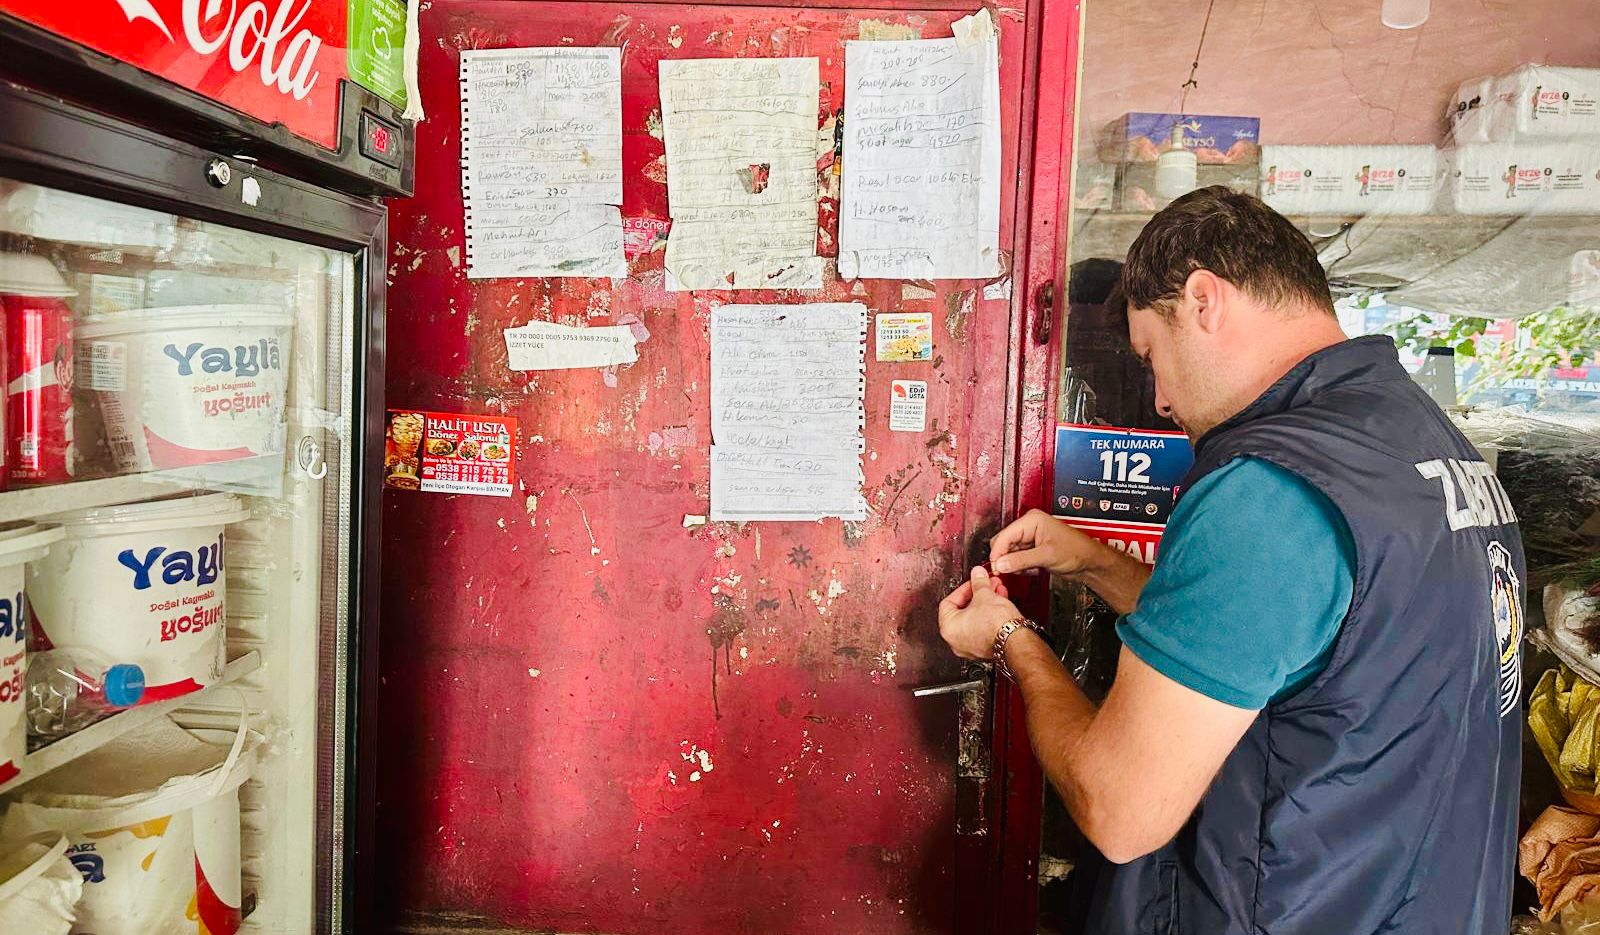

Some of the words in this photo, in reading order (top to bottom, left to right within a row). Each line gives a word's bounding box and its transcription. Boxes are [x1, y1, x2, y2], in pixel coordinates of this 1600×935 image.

[182, 0, 322, 100] Cola
[1518, 169, 1541, 177] erze
[635, 218, 670, 230] döner
[193, 384, 218, 393] Doğal
[204, 391, 271, 416] yoğurt
[427, 418, 470, 432] HALİT
[473, 421, 508, 434] USTA
[428, 430, 458, 439] Döner
[463, 432, 498, 442] Salonu
[1090, 440, 1111, 450] TEK
[1113, 440, 1165, 449] NUMARA
[436, 463, 459, 472] 0538
[462, 465, 480, 474] 215
[483, 466, 494, 475] 75
[497, 467, 509, 476] 78
[1100, 450, 1152, 484] 112
[435, 472, 459, 480] 0538
[482, 474, 494, 483] 75
[496, 476, 508, 484] 78
[150, 599, 179, 612] Doğal
